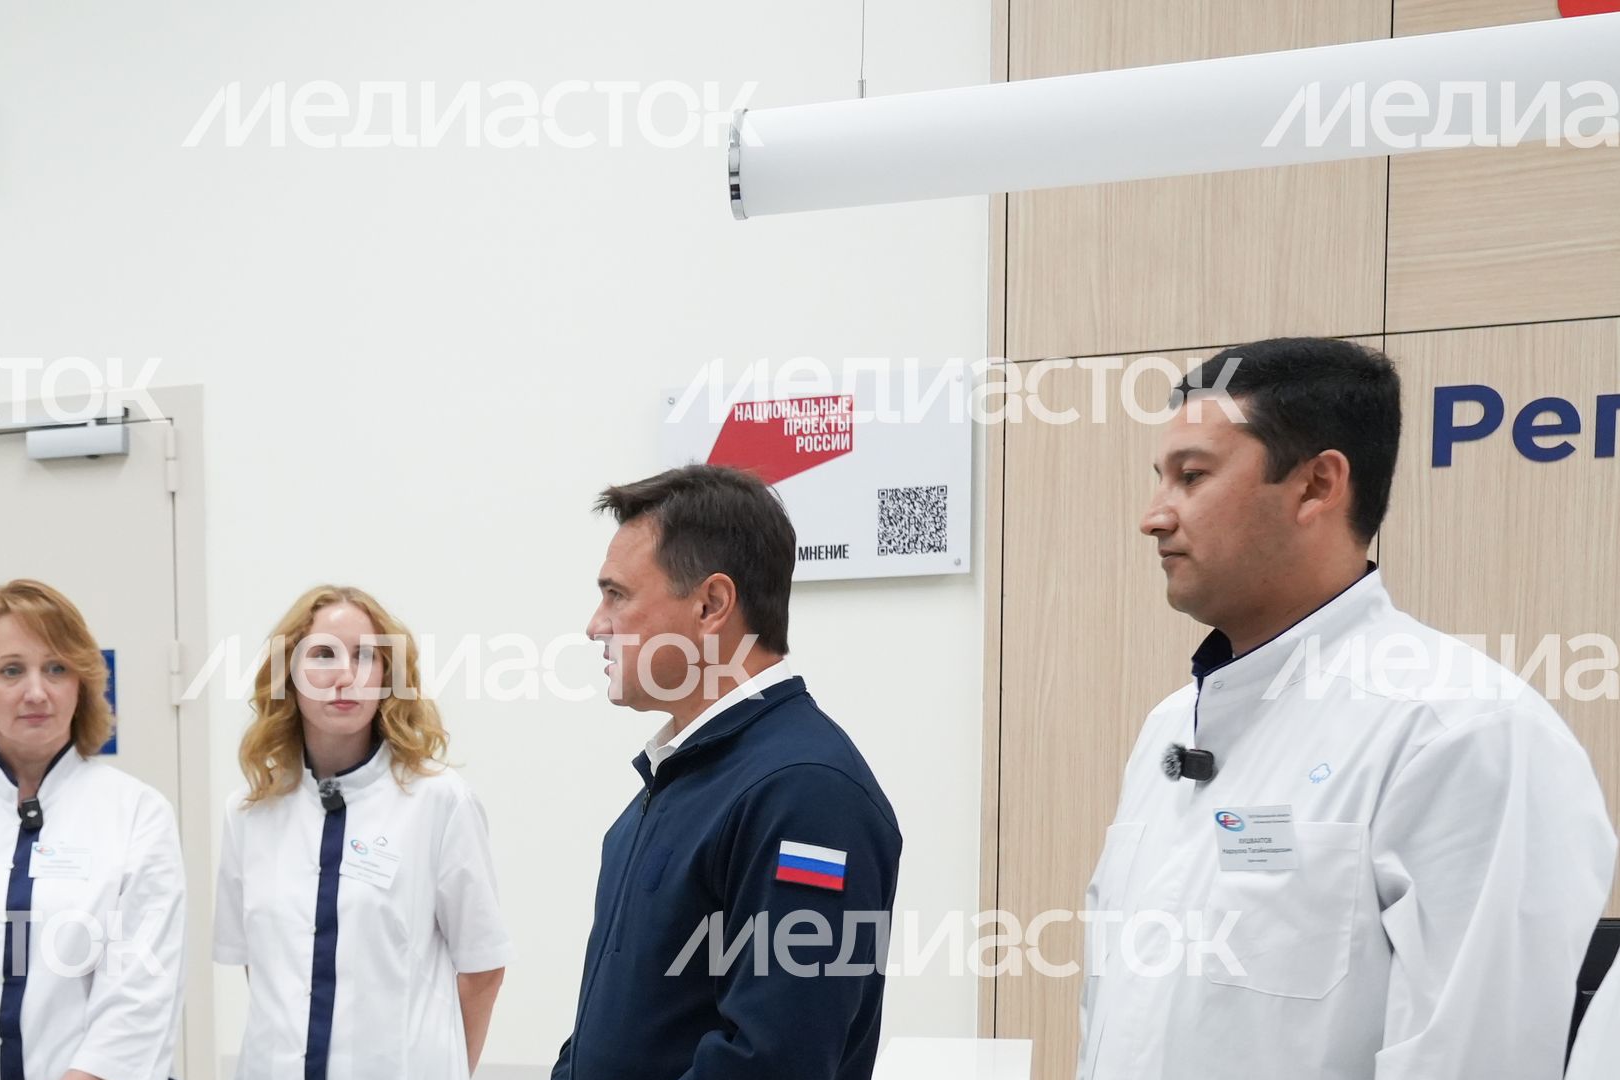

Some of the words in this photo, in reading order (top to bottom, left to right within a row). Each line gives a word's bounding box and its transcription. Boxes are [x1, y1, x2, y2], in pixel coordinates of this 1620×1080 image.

[734, 396, 851, 422] НАЦИОНАЛЬНЫЕ
[783, 414, 851, 436] ПРОЕКТЫ
[795, 433, 850, 453] РОССИИ
[797, 544, 850, 561] МНЕНИЕ
